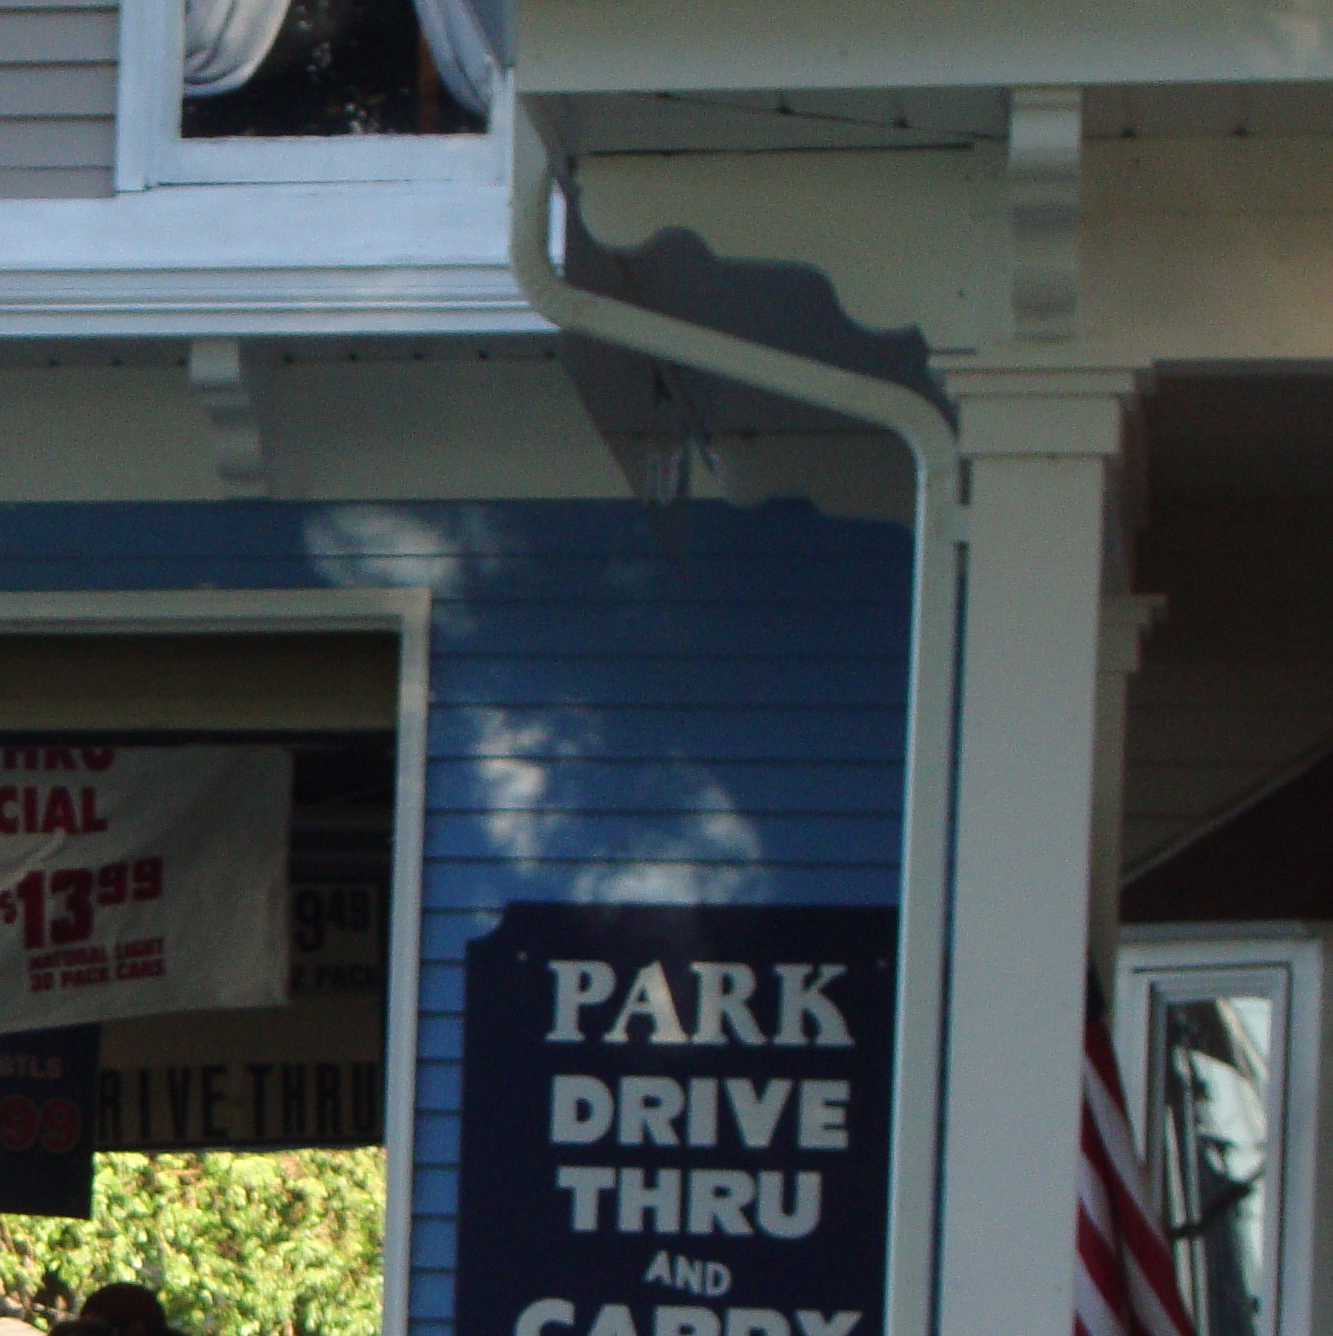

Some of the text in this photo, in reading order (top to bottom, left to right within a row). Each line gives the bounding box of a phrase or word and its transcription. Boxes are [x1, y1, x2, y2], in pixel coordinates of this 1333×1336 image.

[544, 960, 855, 1046] PARK
[99, 1061, 376, 1140] RIVE THRU
[549, 1074, 850, 1149] DRIVE
[557, 1166, 822, 1238] THRU
[644, 1250, 732, 1297] AND
